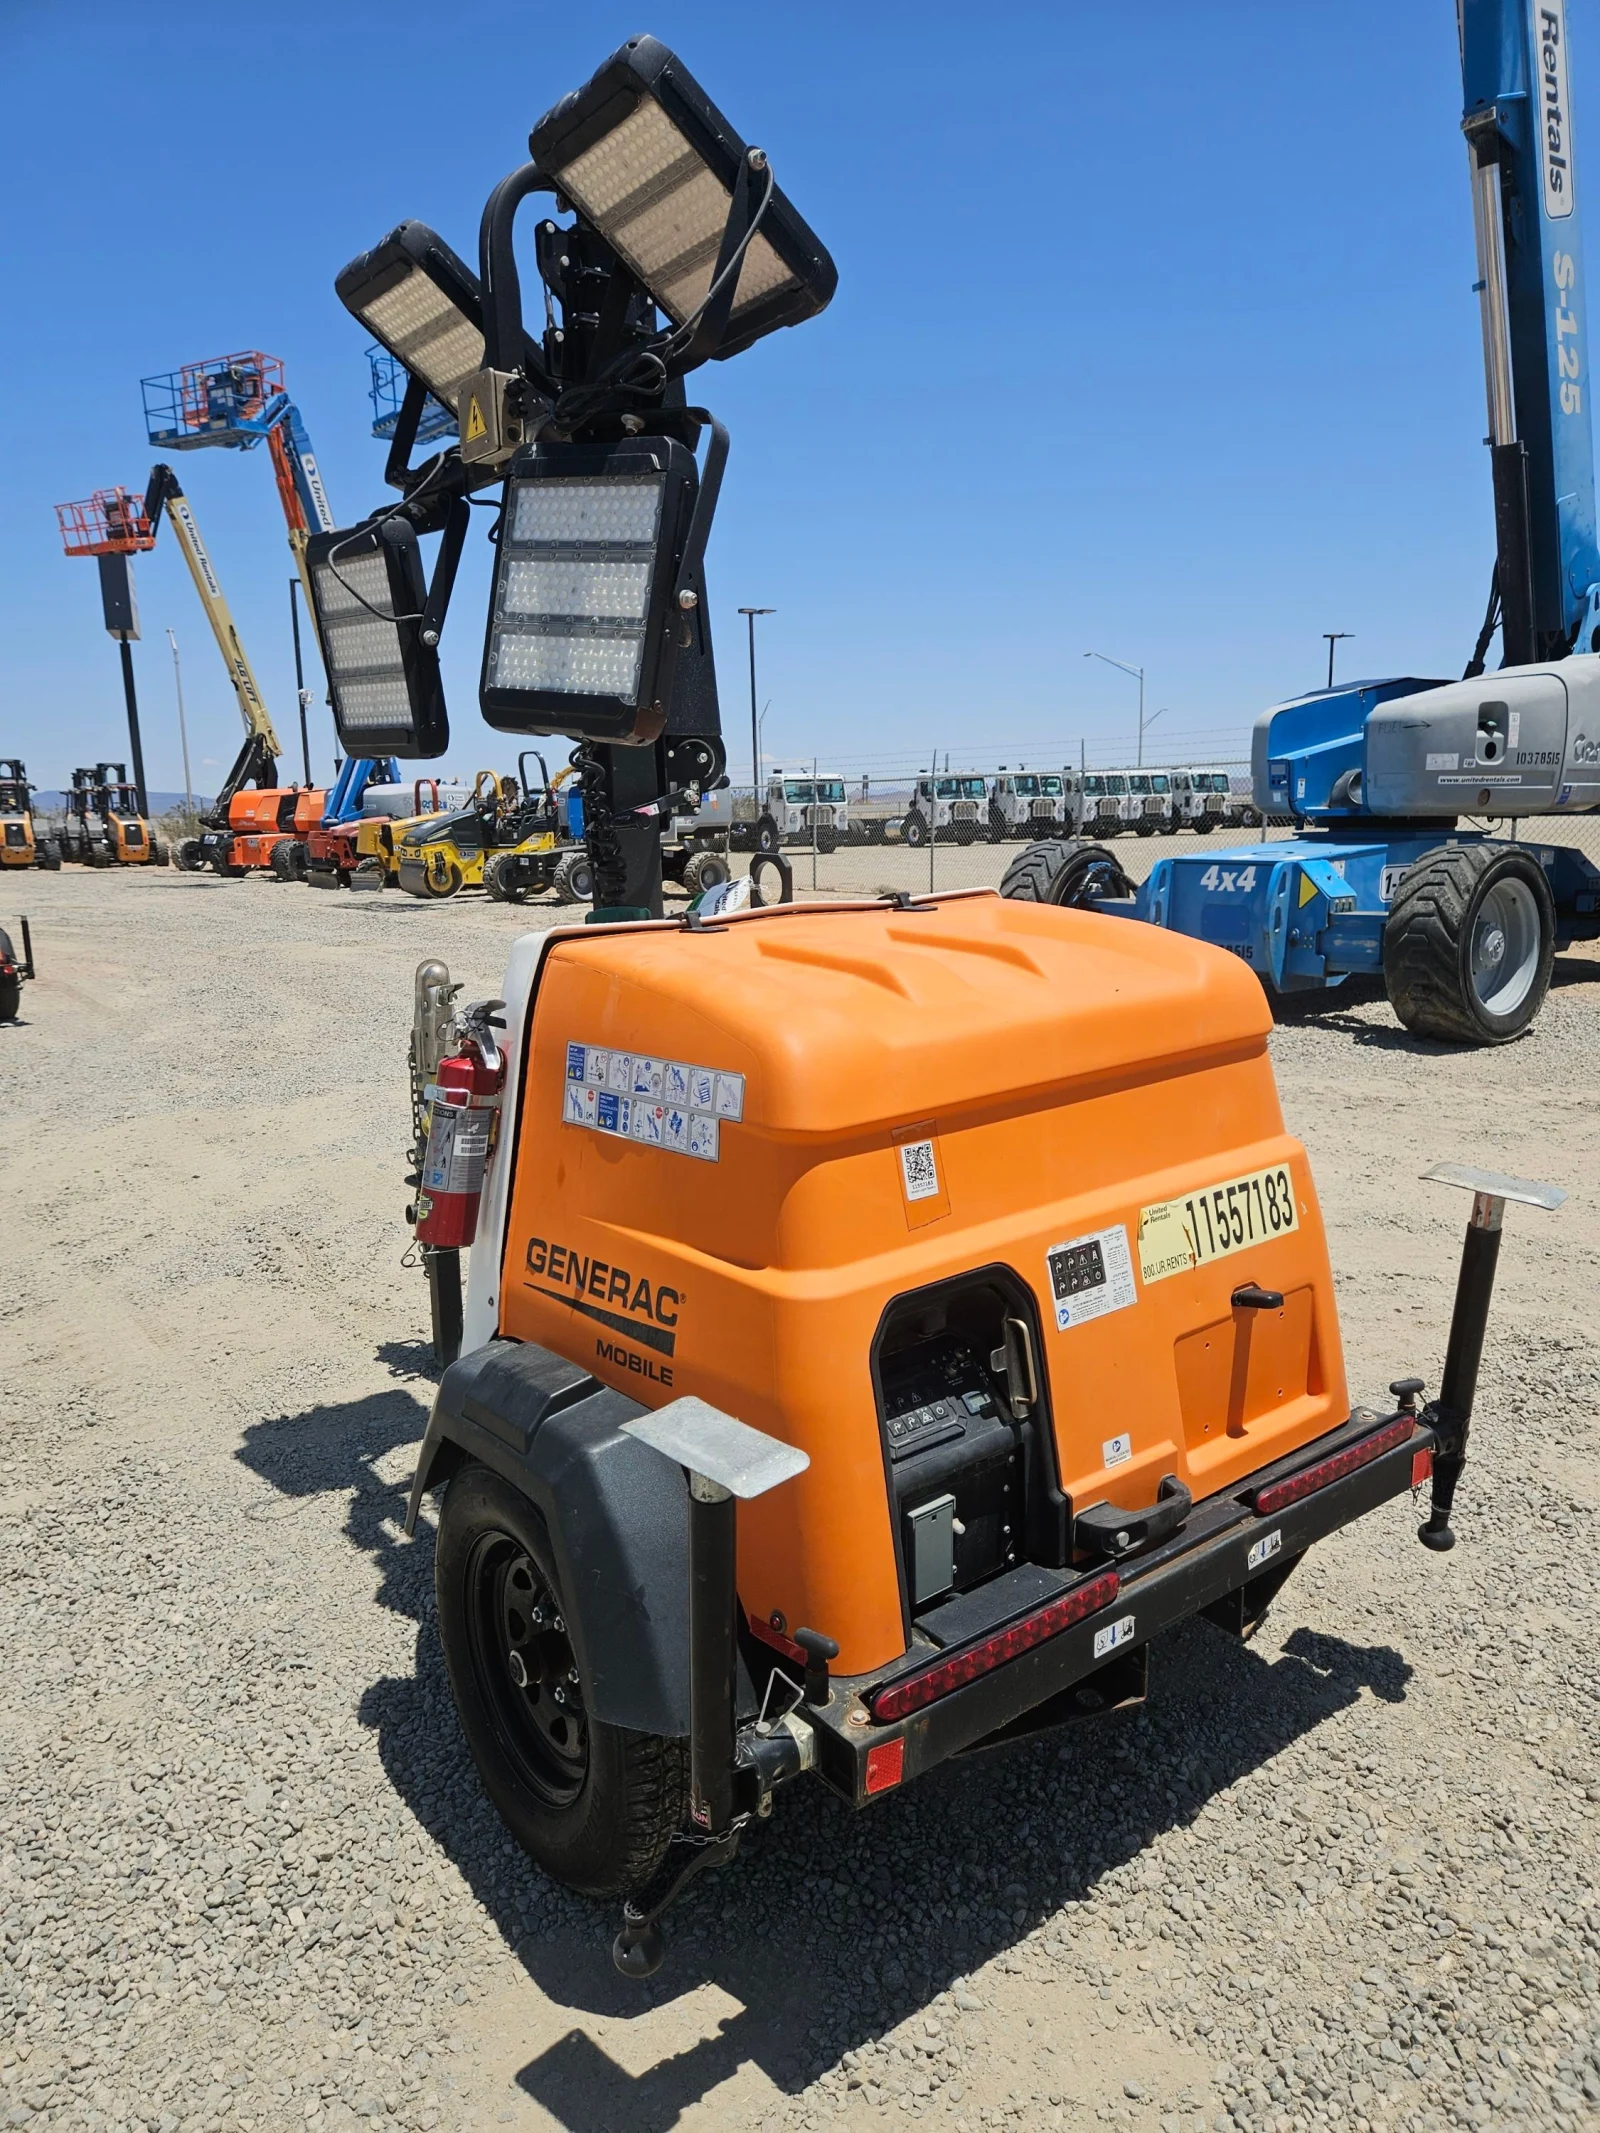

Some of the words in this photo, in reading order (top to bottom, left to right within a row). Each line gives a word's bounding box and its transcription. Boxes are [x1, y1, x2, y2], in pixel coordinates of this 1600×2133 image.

[1540, 7, 1567, 196] Rentals
[1553, 252, 1582, 416] S-125
[311, 480, 332, 526] United
[185, 522, 204, 555] United
[199, 557, 218, 595] Rentals
[234, 658, 247, 677] JLG
[243, 681, 259, 704] LIFT
[1438, 775, 1521, 784] www.unitedrentals.com
[1515, 751, 1561, 766] 10378515
[1200, 865, 1257, 892] 4x4
[1385, 871, 1406, 896] 1-
[1148, 1206, 1168, 1216] United
[1150, 1213, 1171, 1224] Rentals
[1185, 1170, 1294, 1259] 11557183
[526, 1237, 680, 1328] GENERAC
[1143, 1252, 1188, 1279] 800.UR.RENTS
[596, 1338, 674, 1387] MOBILE
